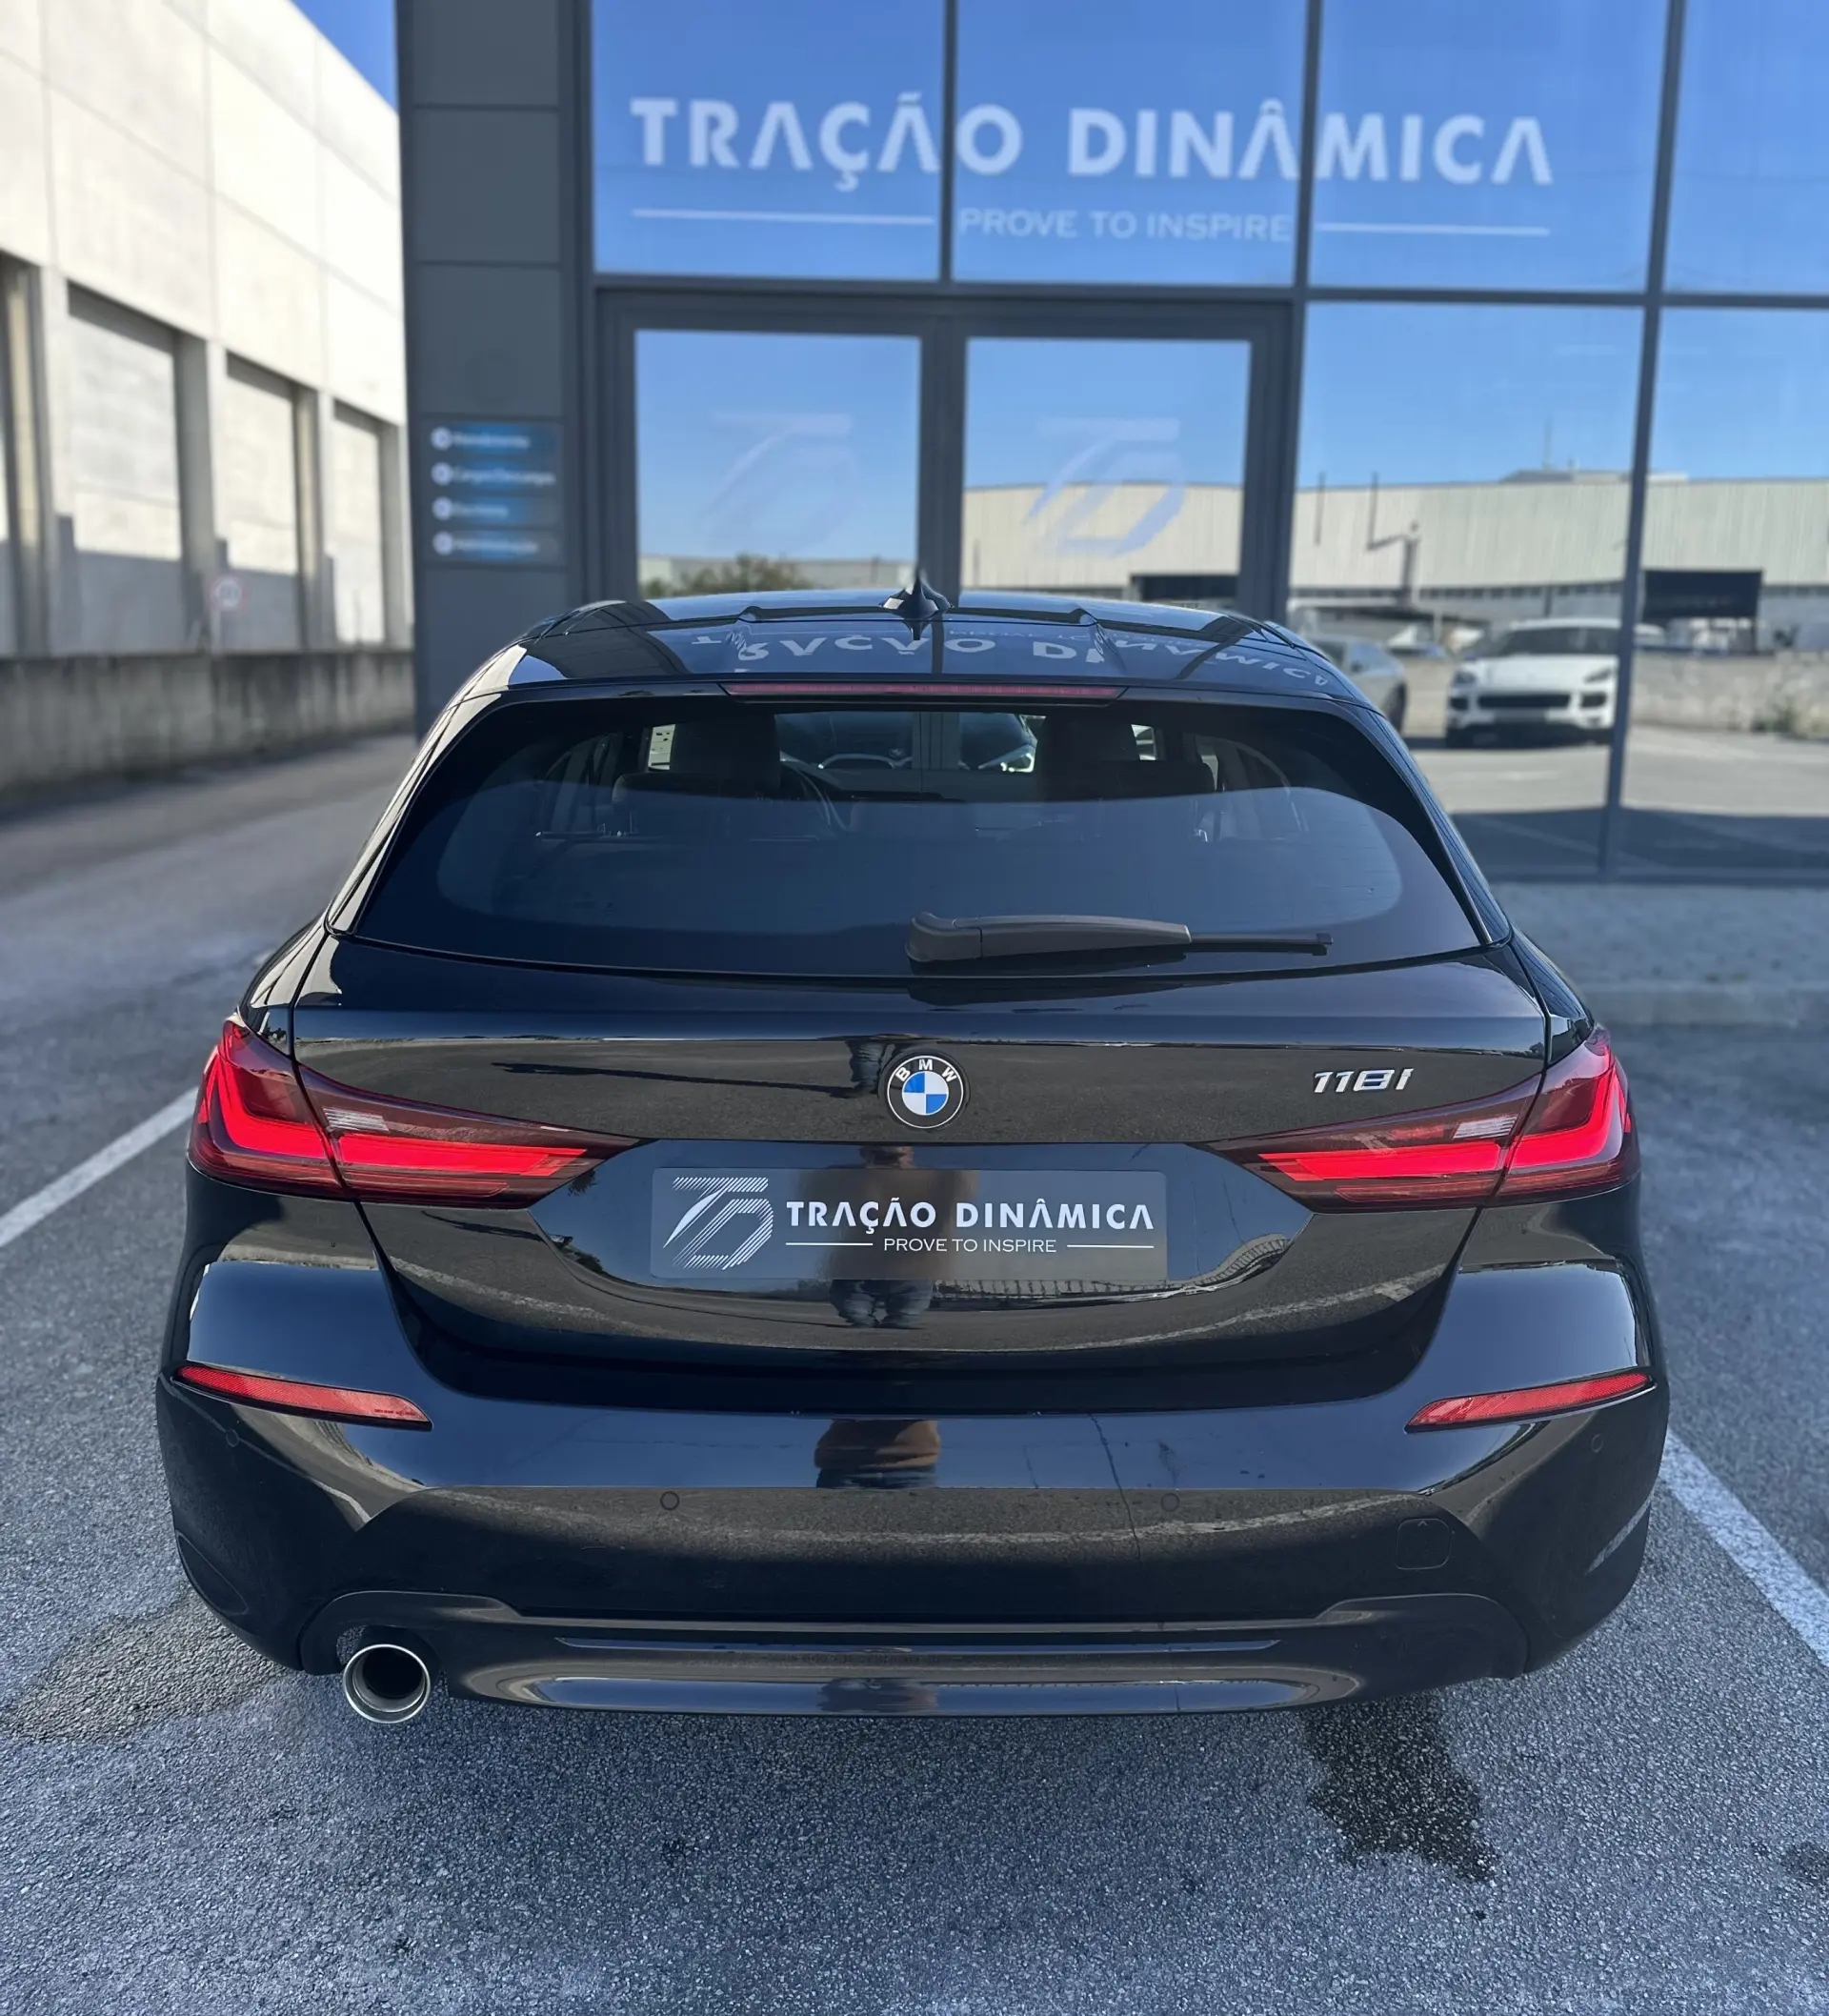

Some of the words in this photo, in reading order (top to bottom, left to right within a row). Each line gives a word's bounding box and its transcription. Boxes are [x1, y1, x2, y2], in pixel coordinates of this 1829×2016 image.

[630, 91, 1024, 192] TRAÇÃO
[1068, 97, 1554, 186] DINÂMICA
[959, 207, 1078, 238] PROVE
[1088, 210, 1138, 239] TO
[1146, 212, 1293, 243] INSPIRE
[895, 1058, 957, 1082] BMW
[786, 1197, 936, 1235] TRAÇÃO
[955, 1198, 1155, 1230] DINÂMICA
[884, 1238, 948, 1252] PROVE
[952, 1239, 978, 1252] TO
[983, 1239, 1056, 1253] INSPIRE
